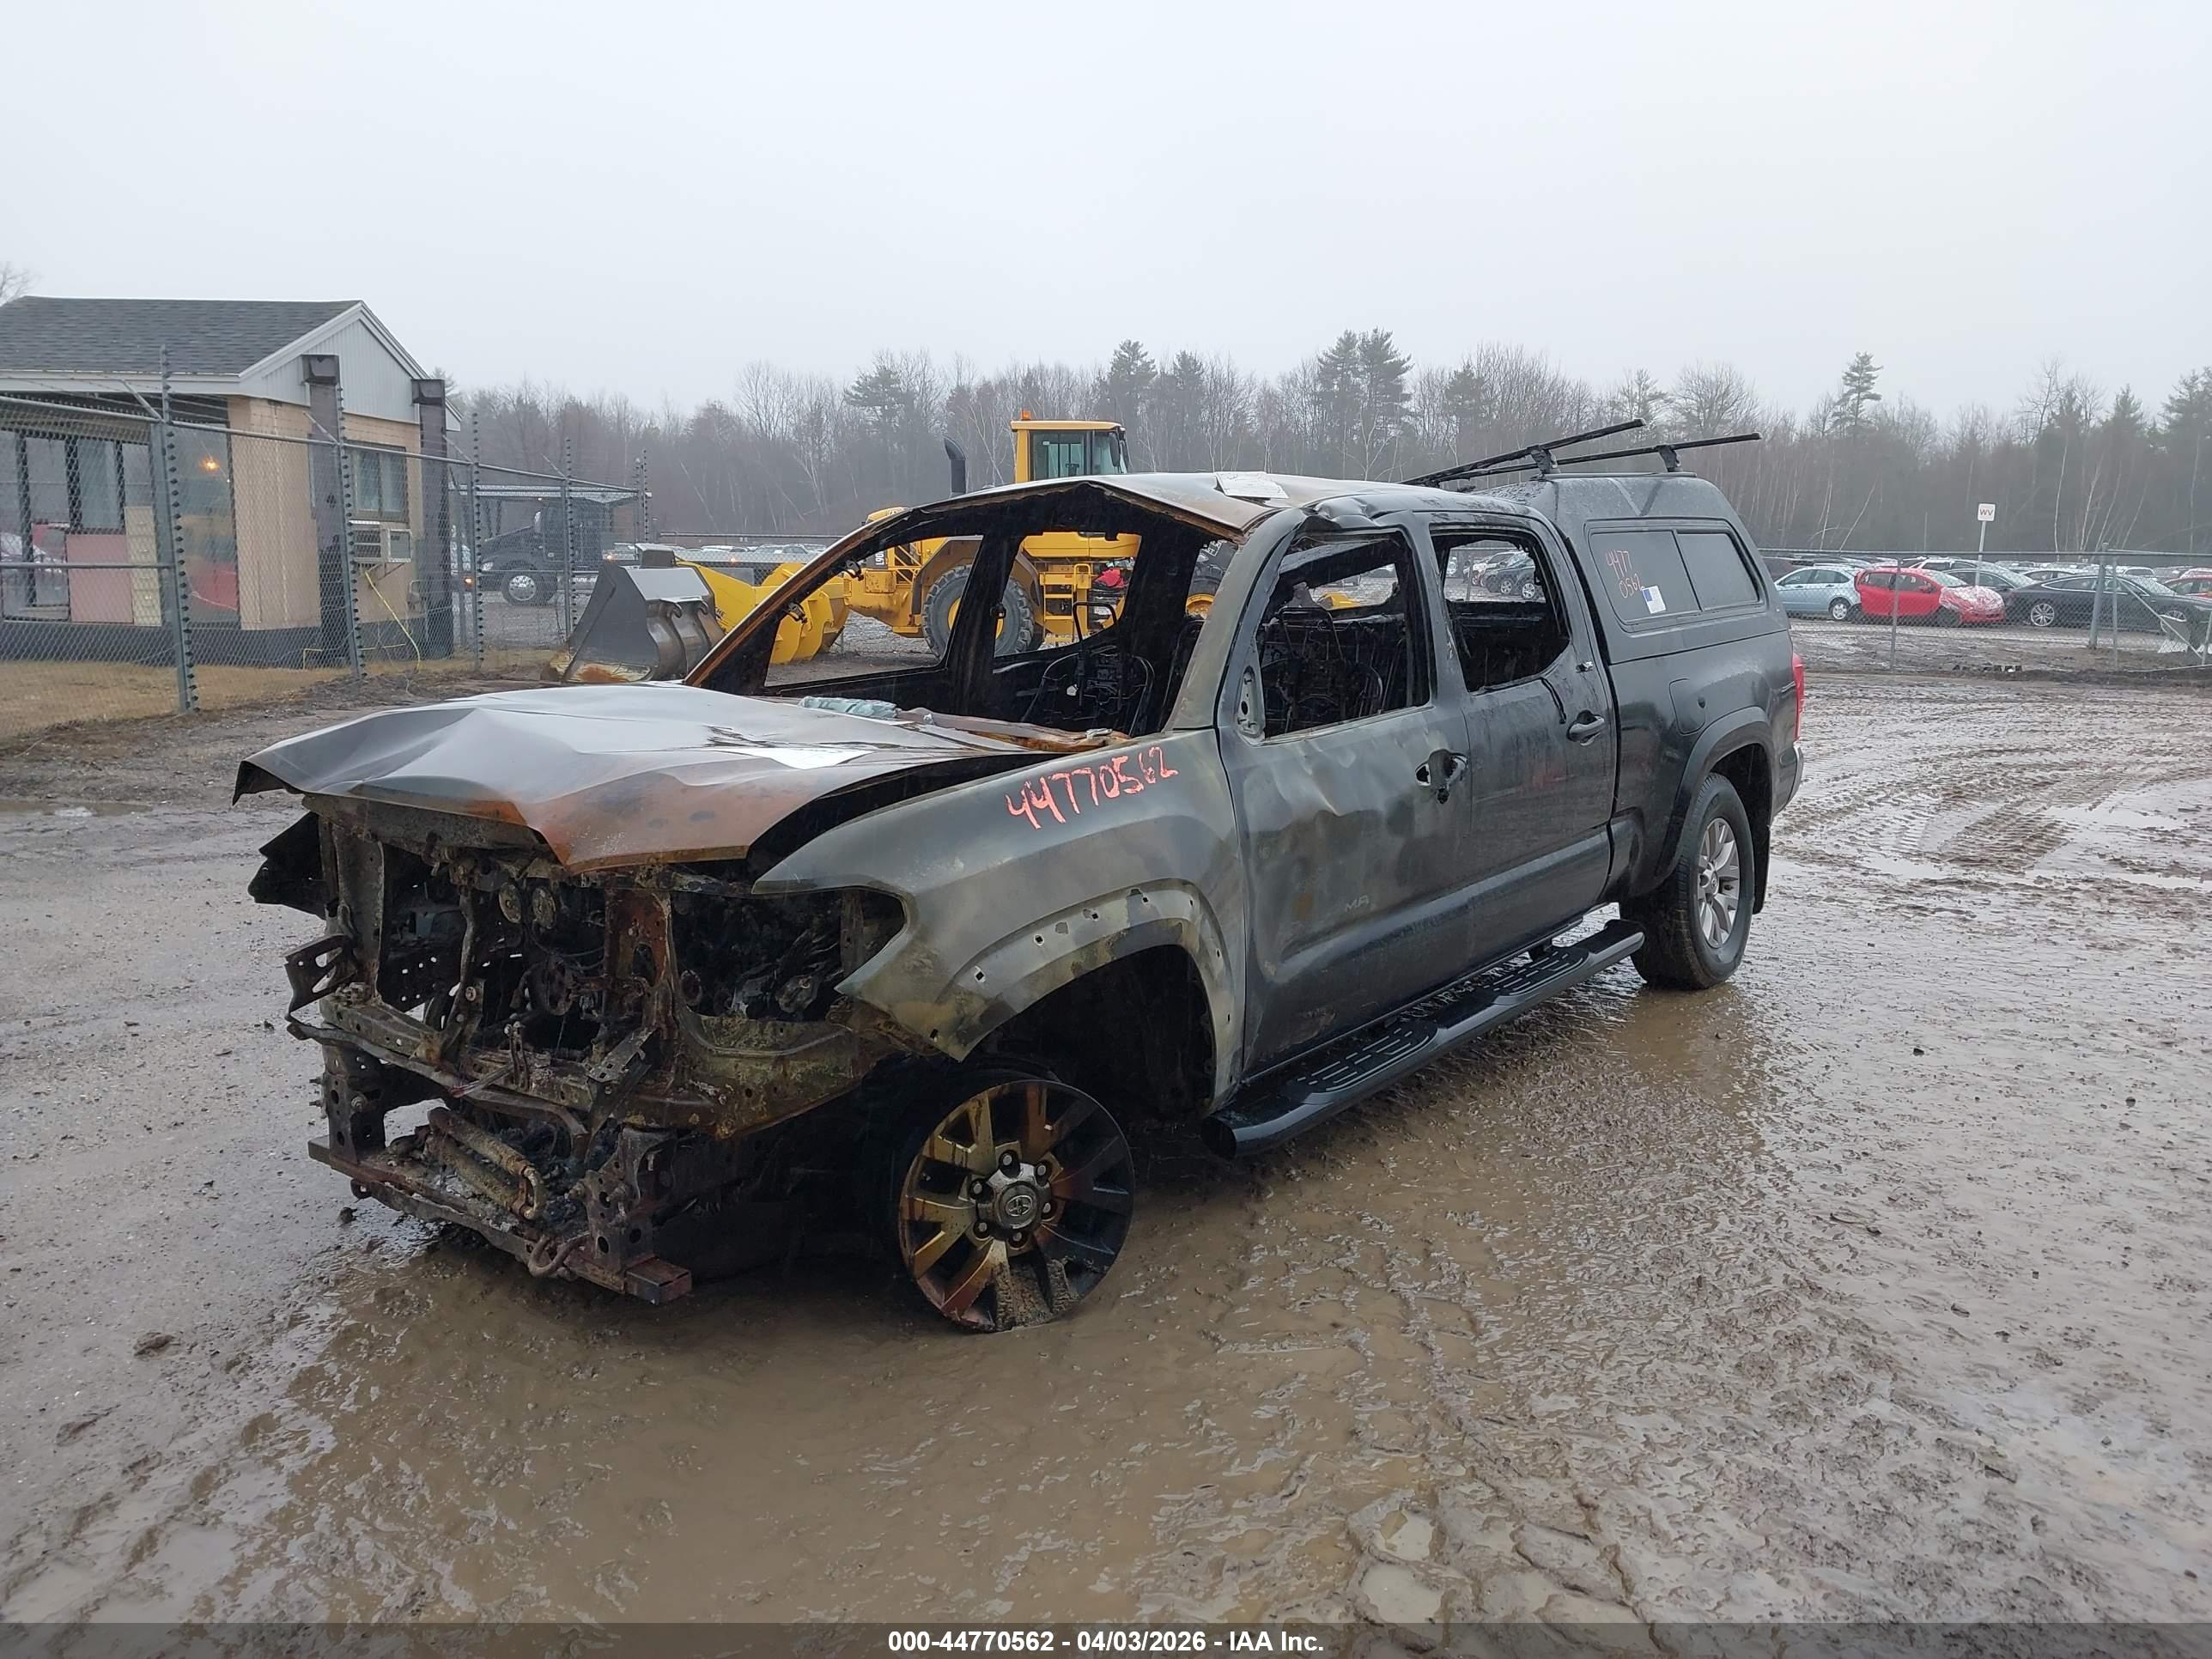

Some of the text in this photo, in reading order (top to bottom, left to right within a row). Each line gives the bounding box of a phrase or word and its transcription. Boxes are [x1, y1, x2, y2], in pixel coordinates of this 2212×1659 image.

[1604, 549, 1632, 580] 4477
[1619, 573, 1645, 599] 0562
[1005, 746, 1179, 830] 44770562
